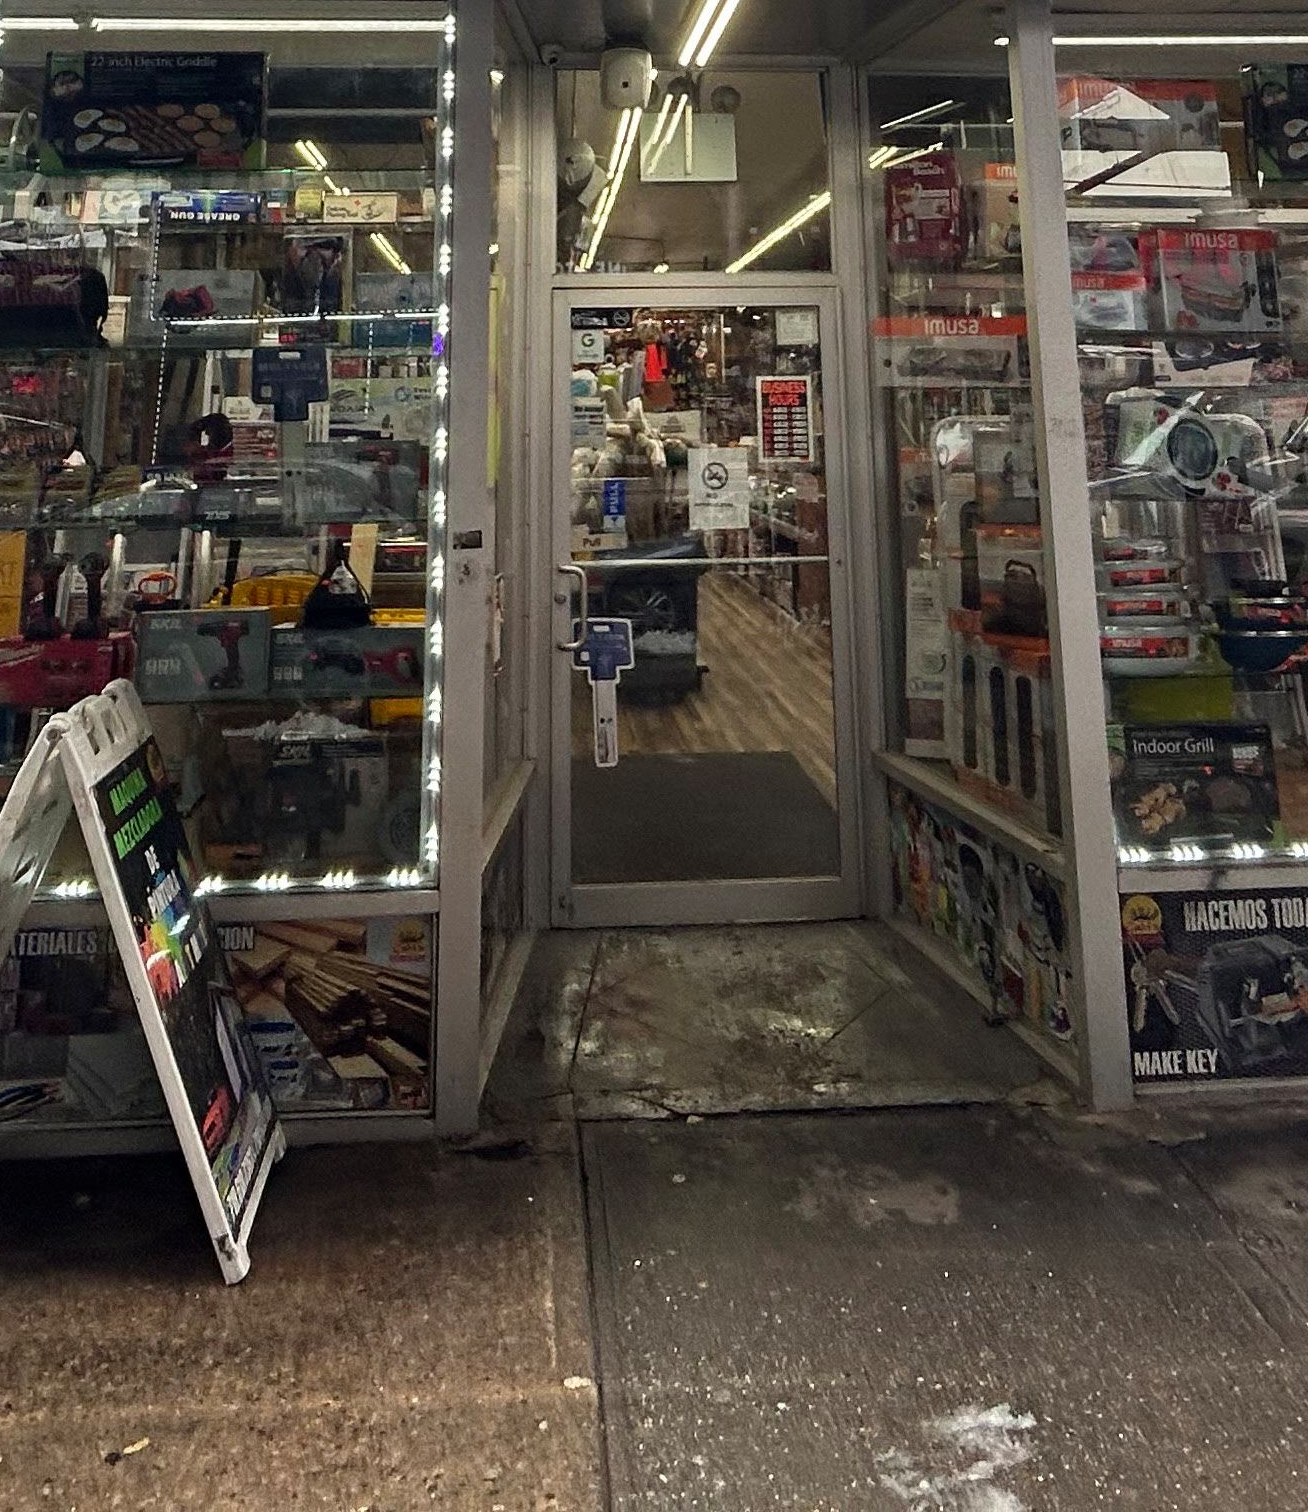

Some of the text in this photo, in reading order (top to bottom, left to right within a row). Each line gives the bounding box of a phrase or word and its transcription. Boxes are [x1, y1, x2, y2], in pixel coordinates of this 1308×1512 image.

[1184, 231, 1238, 249] imusa
[924, 316, 979, 335] imusa
[1132, 738, 1183, 754] Indoor
[1184, 737, 1215, 754] Grill
[144, 844, 161, 876] DE
[1183, 898, 1269, 932] HACEMOS
[1133, 1047, 1219, 1076] MAKE KEY
